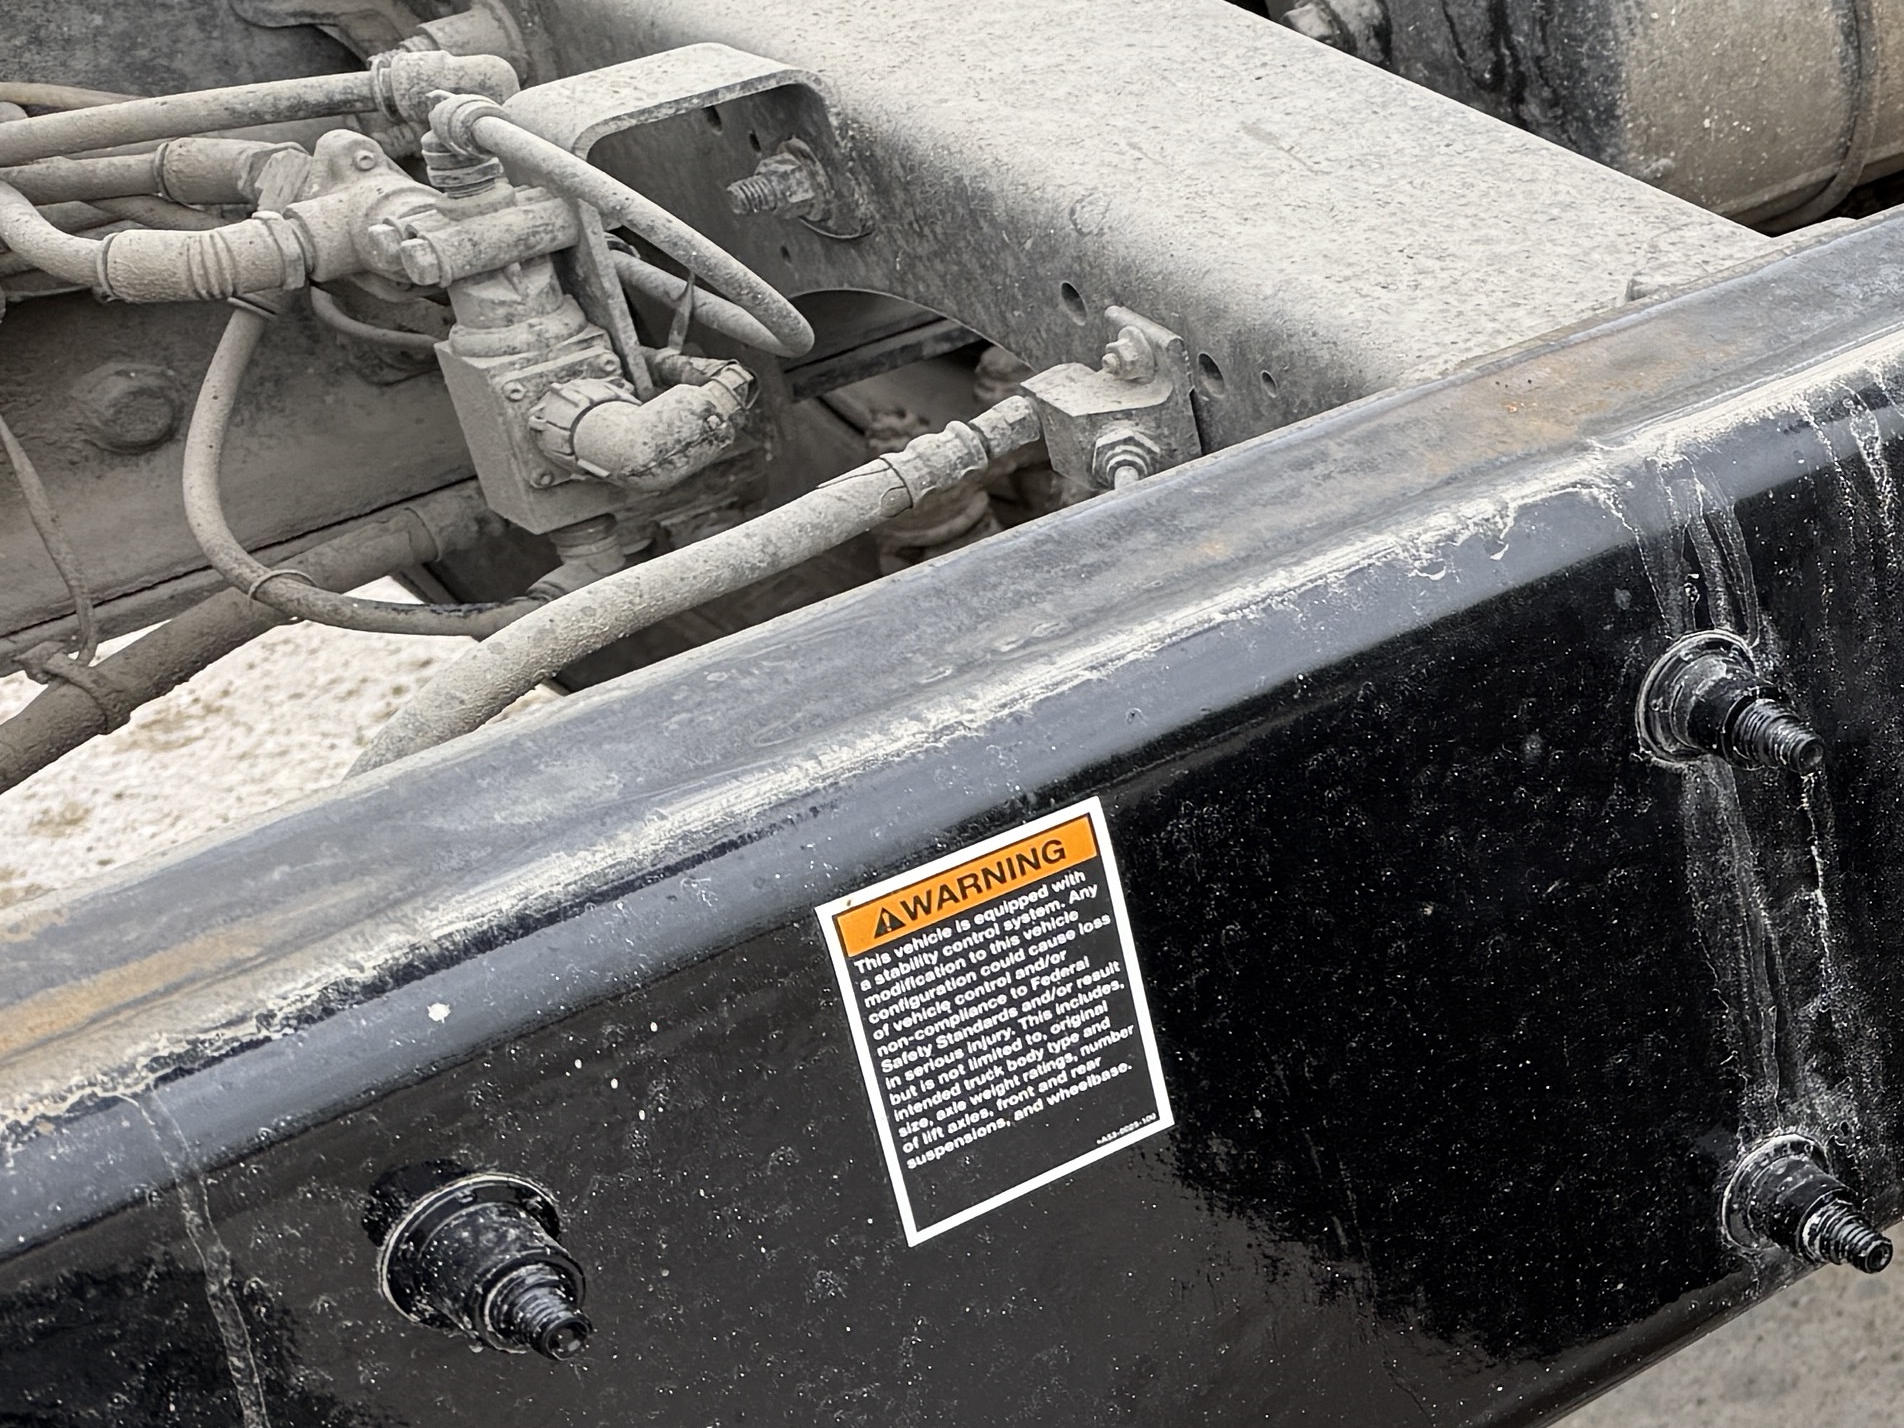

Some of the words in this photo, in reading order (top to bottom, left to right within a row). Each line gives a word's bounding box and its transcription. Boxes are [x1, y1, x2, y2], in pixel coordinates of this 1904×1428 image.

[853, 952, 892, 974] This
[893, 927, 953, 958] vehicle
[955, 919, 971, 933] is
[973, 884, 1049, 925] equipped
[1051, 871, 1086, 893] with
[899, 839, 1066, 922] WARNING
[860, 979, 872, 992] a
[874, 950, 939, 985] stability
[942, 922, 1001, 957] control
[1003, 900, 1066, 931] system.
[1068, 884, 1098, 905] Any
[864, 957, 967, 1008] modification
[968, 949, 987, 964] to
[989, 935, 1021, 955] this
[1022, 910, 1079, 940] vehicle
[868, 971, 977, 1024] configuration
[980, 947, 1026, 977] could
[1028, 929, 1076, 956] cause
[1078, 914, 1111, 935] loss
[872, 1022, 890, 1041] of
[892, 1000, 952, 1032] vehicle
[954, 971, 1012, 1006] control
[1015, 950, 1067, 980] and/or
[876, 994, 1008, 1058] non-compliance
[1010, 985, 1028, 999] to
[1030, 955, 1090, 991] Federal
[880, 1043, 933, 1073] Safety
[935, 1007, 1019, 1049] Standards
[1021, 982, 1073, 1012] and/or
[1076, 960, 1121, 989] result
[885, 1075, 902, 1090] in
[904, 1048, 965, 1081] serious
[966, 1026, 1016, 1054] injury.
[1017, 1009, 1053, 1030] This
[1055, 980, 1125, 1015] includes,
[889, 1084, 918, 1106] but
[919, 1079, 936, 1093] is
[937, 1063, 966, 1085] not
[967, 1037, 1023, 1071] limited
[1025, 1031, 1048, 1046] to,
[1050, 999, 1108, 1035] original
[893, 1082, 962, 1122] intended
[963, 1065, 1005, 1091] truck
[1006, 1047, 1044, 1072] body
[1046, 1032, 1080, 1054] type
[1083, 1016, 1111, 1038] and
[898, 1117, 934, 1138] size,
[936, 1100, 967, 1121] axle
[969, 1074, 1021, 1106] weight
[1022, 1052, 1078, 1083] ratings,
[1079, 1024, 1134, 1057] number
[902, 1136, 920, 1154] of
[921, 1126, 945, 1145] lift
[947, 1108, 994, 1134] axles,
[996, 1085, 1036, 1111] front
[1038, 1069, 1068, 1093] and
[1070, 1056, 1102, 1079] rear
[906, 1117, 1011, 1169] suspensions,
[1014, 1097, 1044, 1121] and
[1046, 1062, 1132, 1106] wheelbase.
